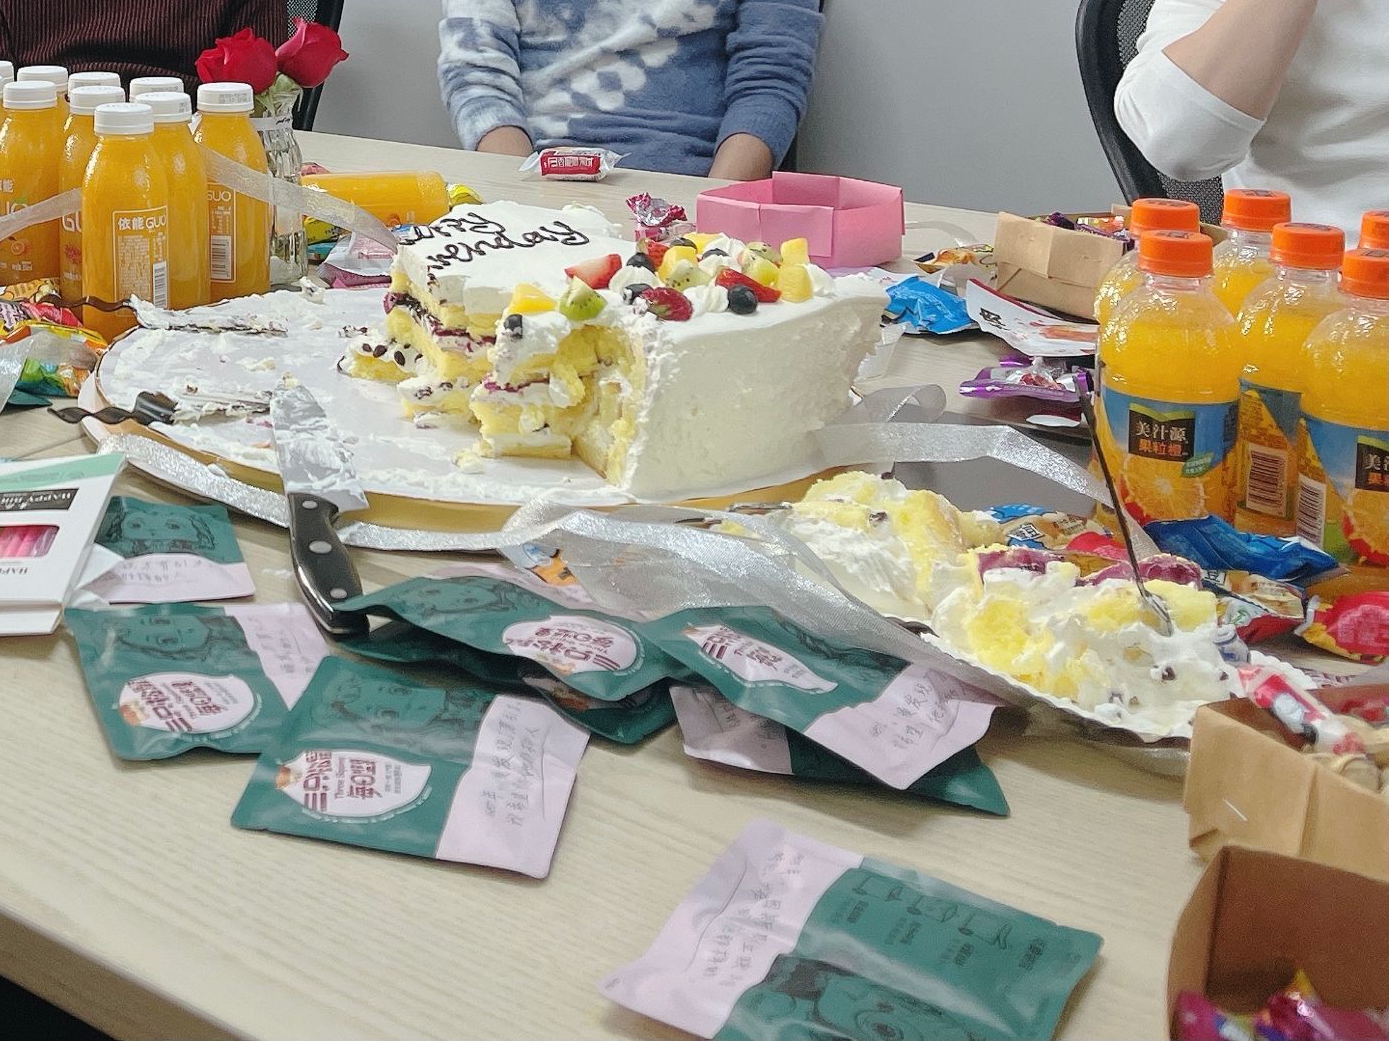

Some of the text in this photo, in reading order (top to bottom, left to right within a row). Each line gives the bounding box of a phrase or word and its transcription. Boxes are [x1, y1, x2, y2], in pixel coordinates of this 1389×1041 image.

[117, 216, 145, 231] 依能
[1136, 420, 1187, 442] 美汁源
[1139, 438, 1183, 456] 果粒橙
[1368, 472, 1389, 486] 果
[28, 491, 72, 502] HAPPY
